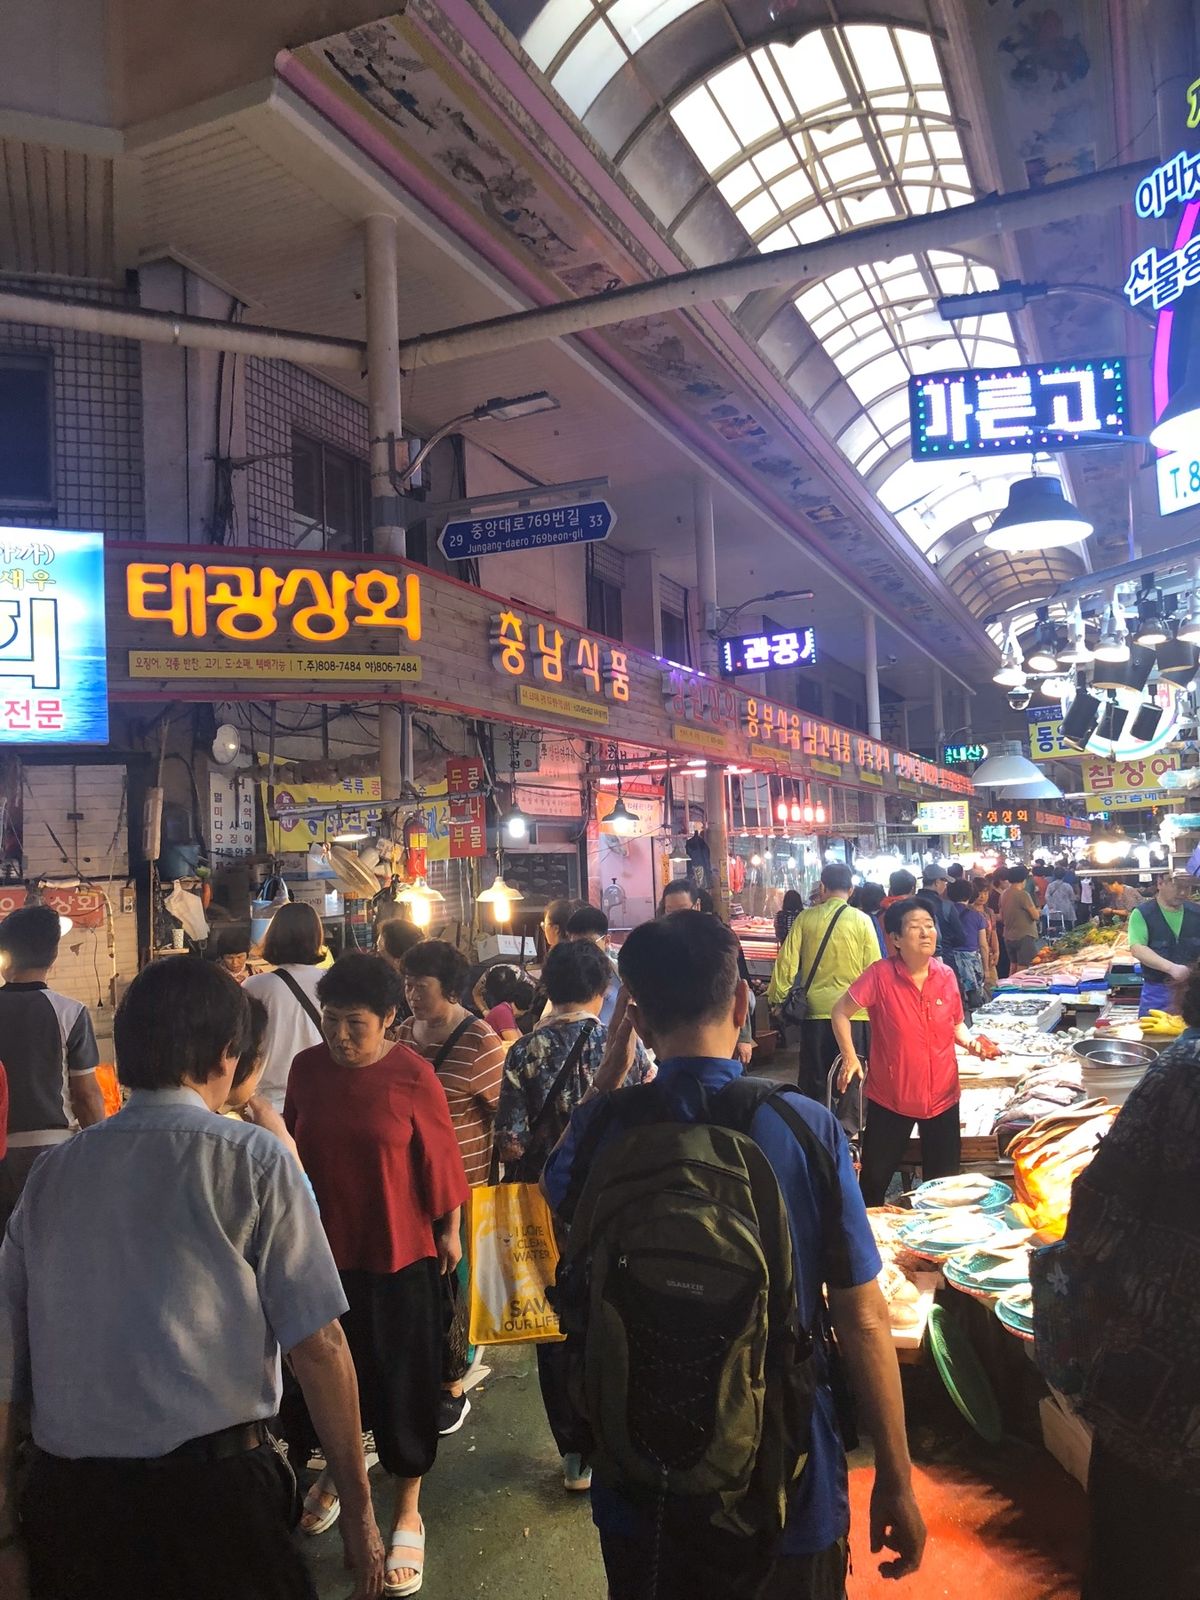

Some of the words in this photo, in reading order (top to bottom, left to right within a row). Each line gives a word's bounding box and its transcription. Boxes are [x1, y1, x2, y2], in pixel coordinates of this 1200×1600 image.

[471, 508, 580, 540] 중앙대로769번길
[588, 514, 603, 528] 33
[450, 534, 464, 547] 29
[467, 538, 529, 554] Jungang-daero
[531, 529, 584, 545] 769beon-gil
[126, 562, 422, 642] 태광상회
[165, 657, 180, 671] 각종
[255, 658, 286, 672] 택배가능
[498, 610, 630, 702] 충남식품
[4, 699, 63, 729] 전문
[1088, 757, 1176, 790] 참상어
[510, 1296, 549, 1317] SAV
[504, 1319, 533, 1332] OUR
